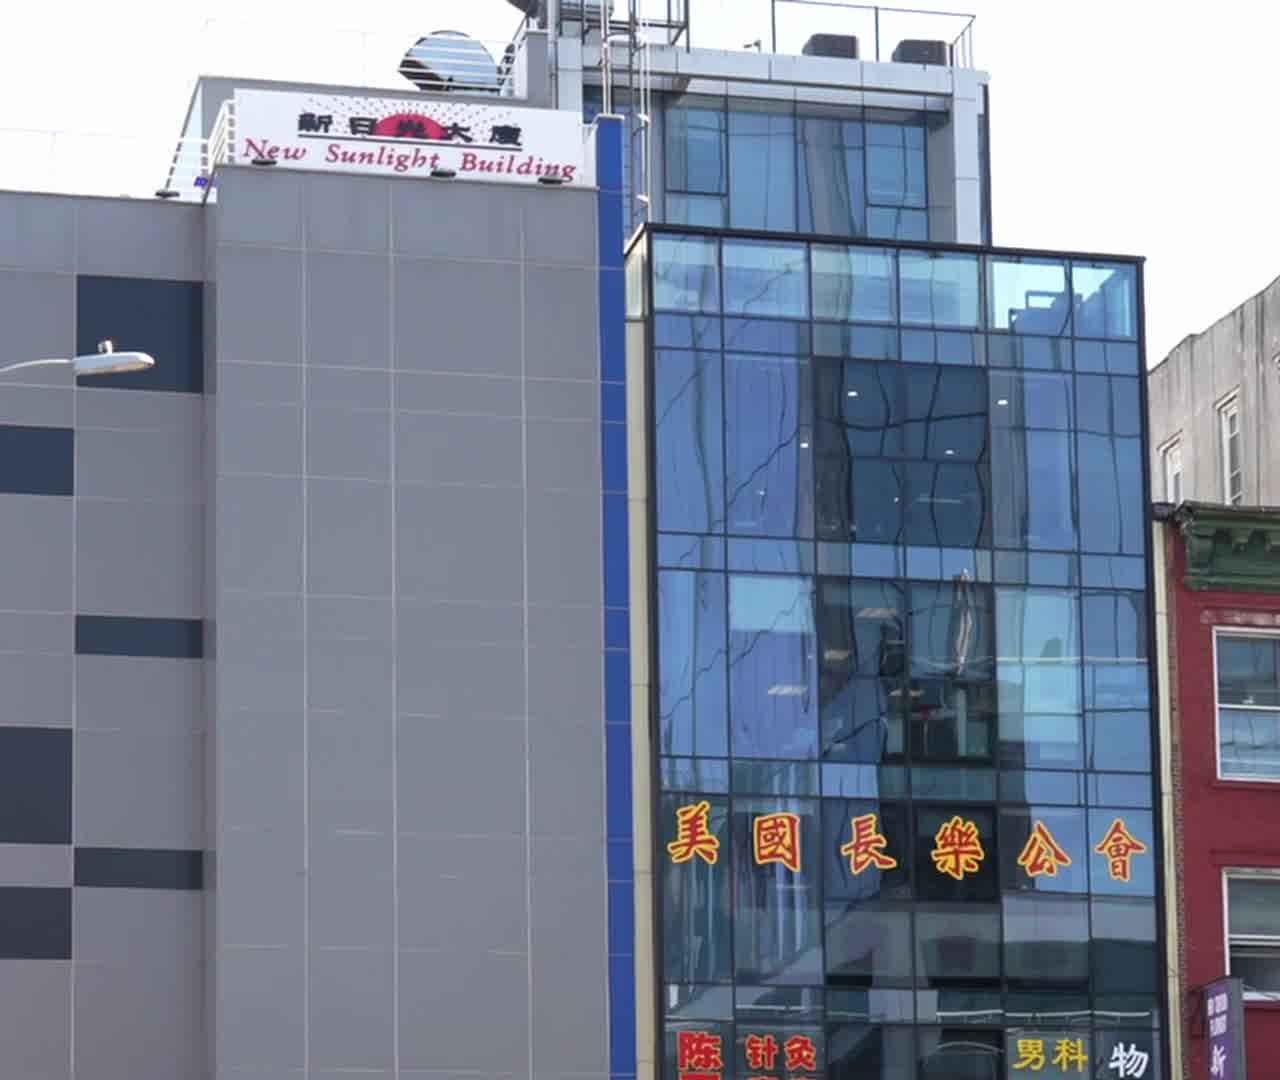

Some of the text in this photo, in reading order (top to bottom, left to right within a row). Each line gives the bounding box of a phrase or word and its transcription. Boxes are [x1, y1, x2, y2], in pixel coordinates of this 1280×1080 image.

[244, 138, 577, 183] New Sunlight Building
[667, 800, 1146, 881] 美國長樂公會
[746, 1035, 817, 1071] 针灸
[1013, 1039, 1089, 1072] 男科
